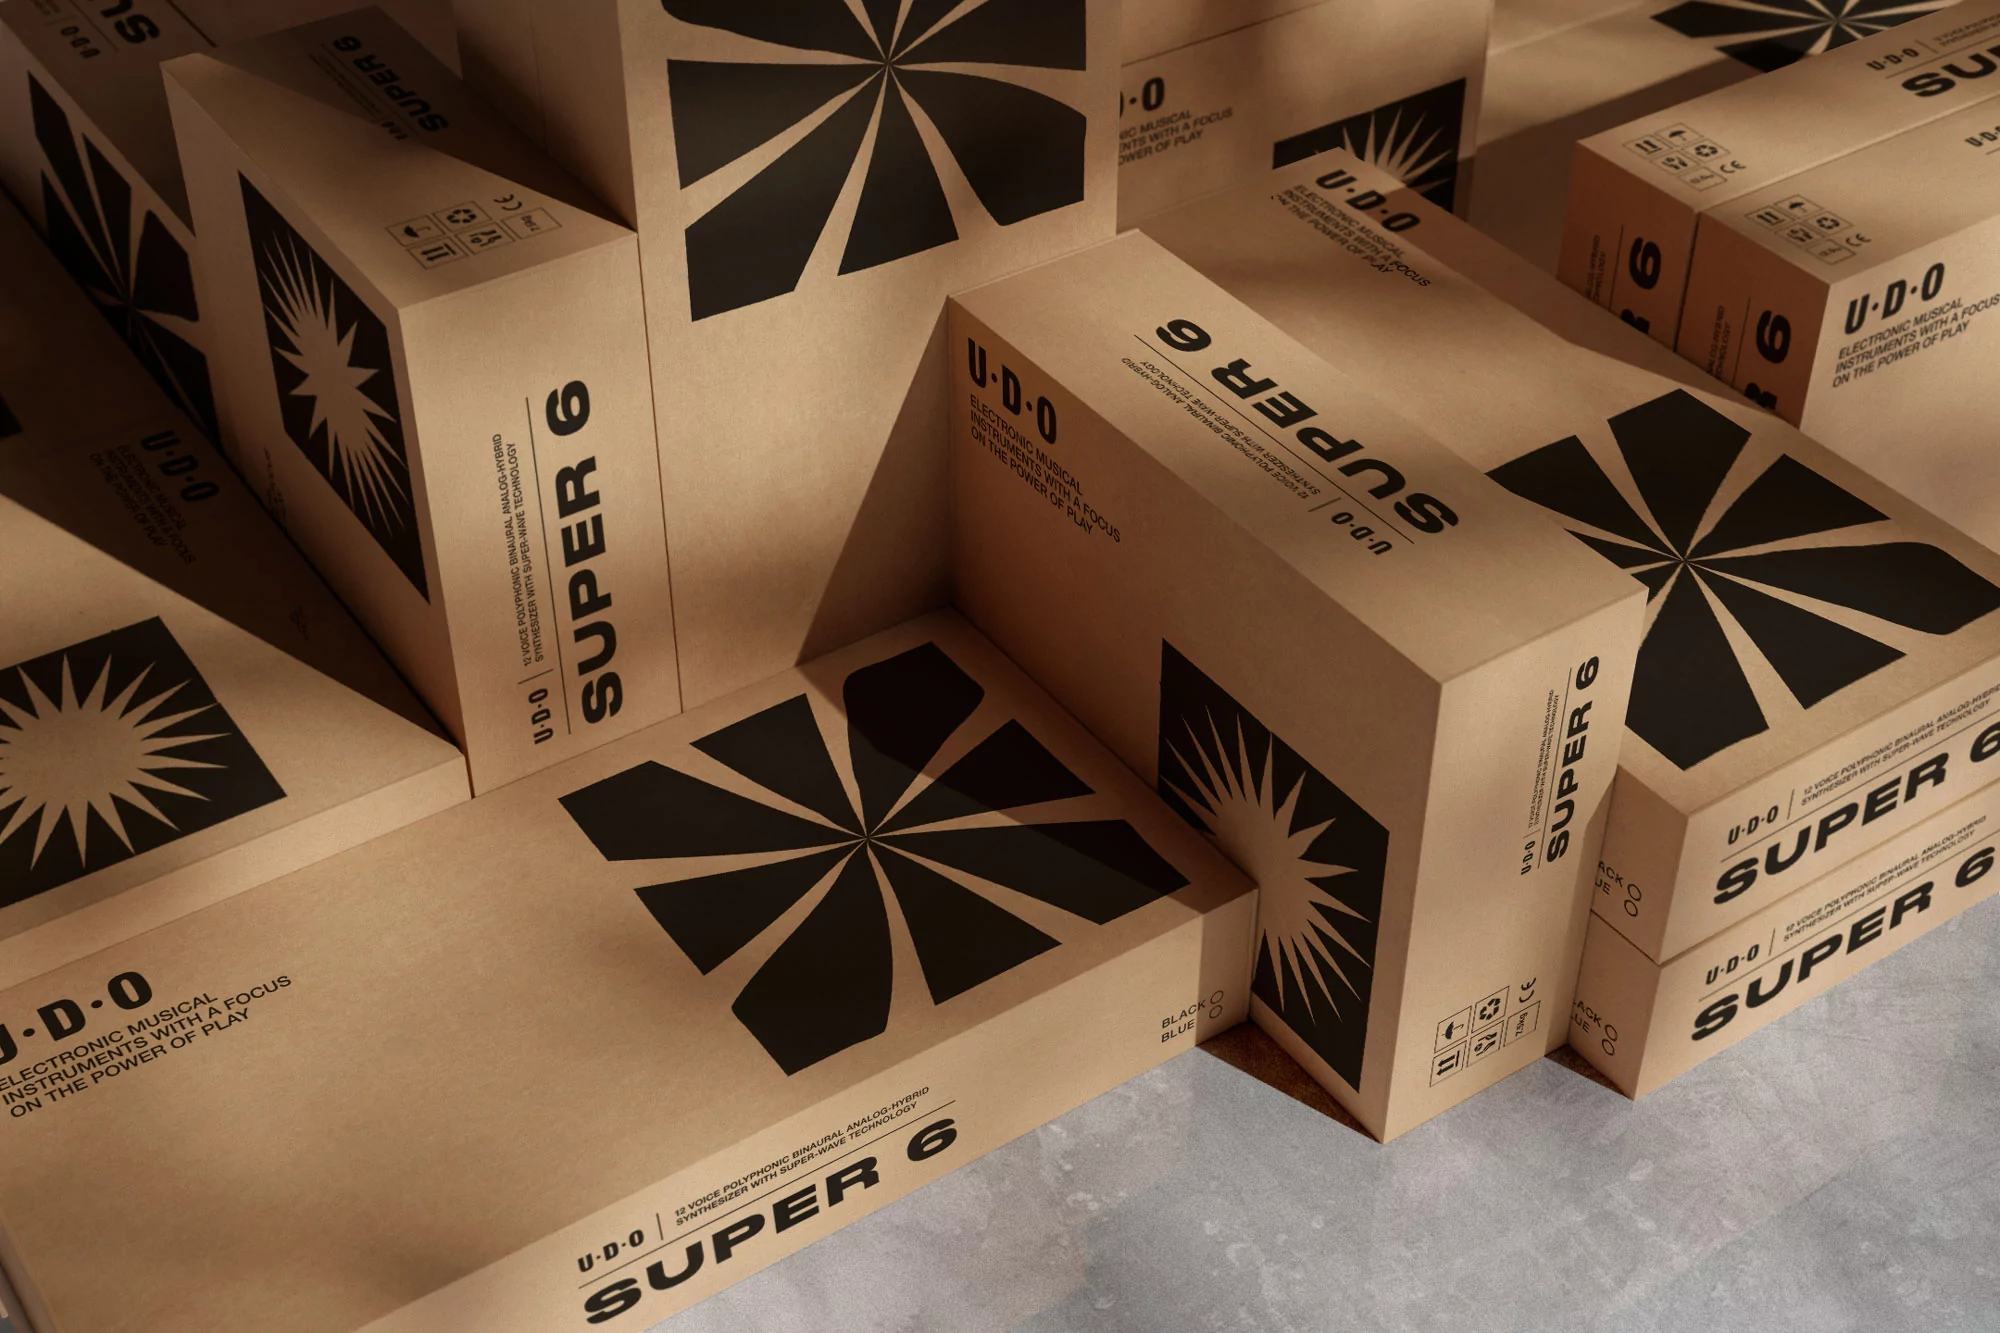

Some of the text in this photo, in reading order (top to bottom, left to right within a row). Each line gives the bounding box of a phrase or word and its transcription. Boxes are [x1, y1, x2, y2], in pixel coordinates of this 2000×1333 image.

[332, 35, 362, 52] 6
[352, 53, 449, 132] SUPER
[1173, 129, 1204, 146] PLAY
[1193, 106, 1233, 127] FOCUS
[1307, 218, 1349, 246] POWER
[1361, 255, 1395, 273] PLAY
[1391, 260, 1431, 287] FOCUS
[1628, 236, 1662, 290] 6
[1756, 310, 1791, 364] 6
[1832, 319, 1970, 388] ON THE POWER OF PLAY
[1835, 293, 2000, 375] INSTRUMENTS WITH A FOCUS
[1838, 297, 1963, 360] ELECTRONIC MUSICAL
[1121, 358, 1186, 405] ANALOG-HYBRID
[1140, 361, 1194, 400] TECHNOLOGY
[1156, 319, 1459, 533] SUPER 6
[1183, 403, 1223, 434] BINAURAL
[1194, 398, 1244, 437] SUPER-WAVE
[970, 393, 1083, 497] ELECTRONIC MUSICAL
[970, 410, 1121, 543] INSTRUMENTS WITH A FOCUS
[970, 426, 1094, 535] ON THE POWER OF PLAY
[492, 434, 531, 666] 12 VOICE POLYPHONIC BINAURAL ANALOG-HYBRID
[506, 442, 544, 662] SYNTHESIZER WITH SUPER-WAVE TECHNOLOGY
[545, 380, 623, 724] SUPER 6
[1546, 656, 1599, 863] SUPER 6
[1801, 698, 1991, 806] SYNTHESIZER WITH SUPER-WAVE TECHNOLOGY
[1813, 772, 1840, 790] VOICE
[1839, 742, 1893, 776] POLYPHONIC
[1894, 720, 1935, 745] BINAURAL
[1713, 720, 2000, 905] SUPER 6
[1783, 829, 1976, 942] SYNTHESIZER WITH SUPER-WAVE TECHNOLOGY
[1796, 907, 1823, 927] VOICE
[1824, 877, 1878, 911] POLYPHONIC
[1878, 854, 1919, 881] BINAURAL
[1921, 815, 1986, 856] ANALOG-HYBRID
[1691, 846, 1996, 1041] SUPER 6
[0, 993, 218, 1091] ELECTRONIC MUSICAL
[2, 975, 292, 1106] INSTRUMENTS WITH A FOCUS
[10, 1007, 249, 1118] ON THE POWER OF PLAY
[1161, 1019, 1195, 1043] BLUE
[1162, 1000, 1206, 1029] BLACK
[674, 1086, 930, 1217] 12 VOICE POLYPHONIC BINAURAL ANALOG-HYBRID
[676, 1101, 918, 1226] SYNTHESIZER WITH SUPER-WAVE TECHNOLOGY
[584, 1118, 958, 1324] SUPER 6
